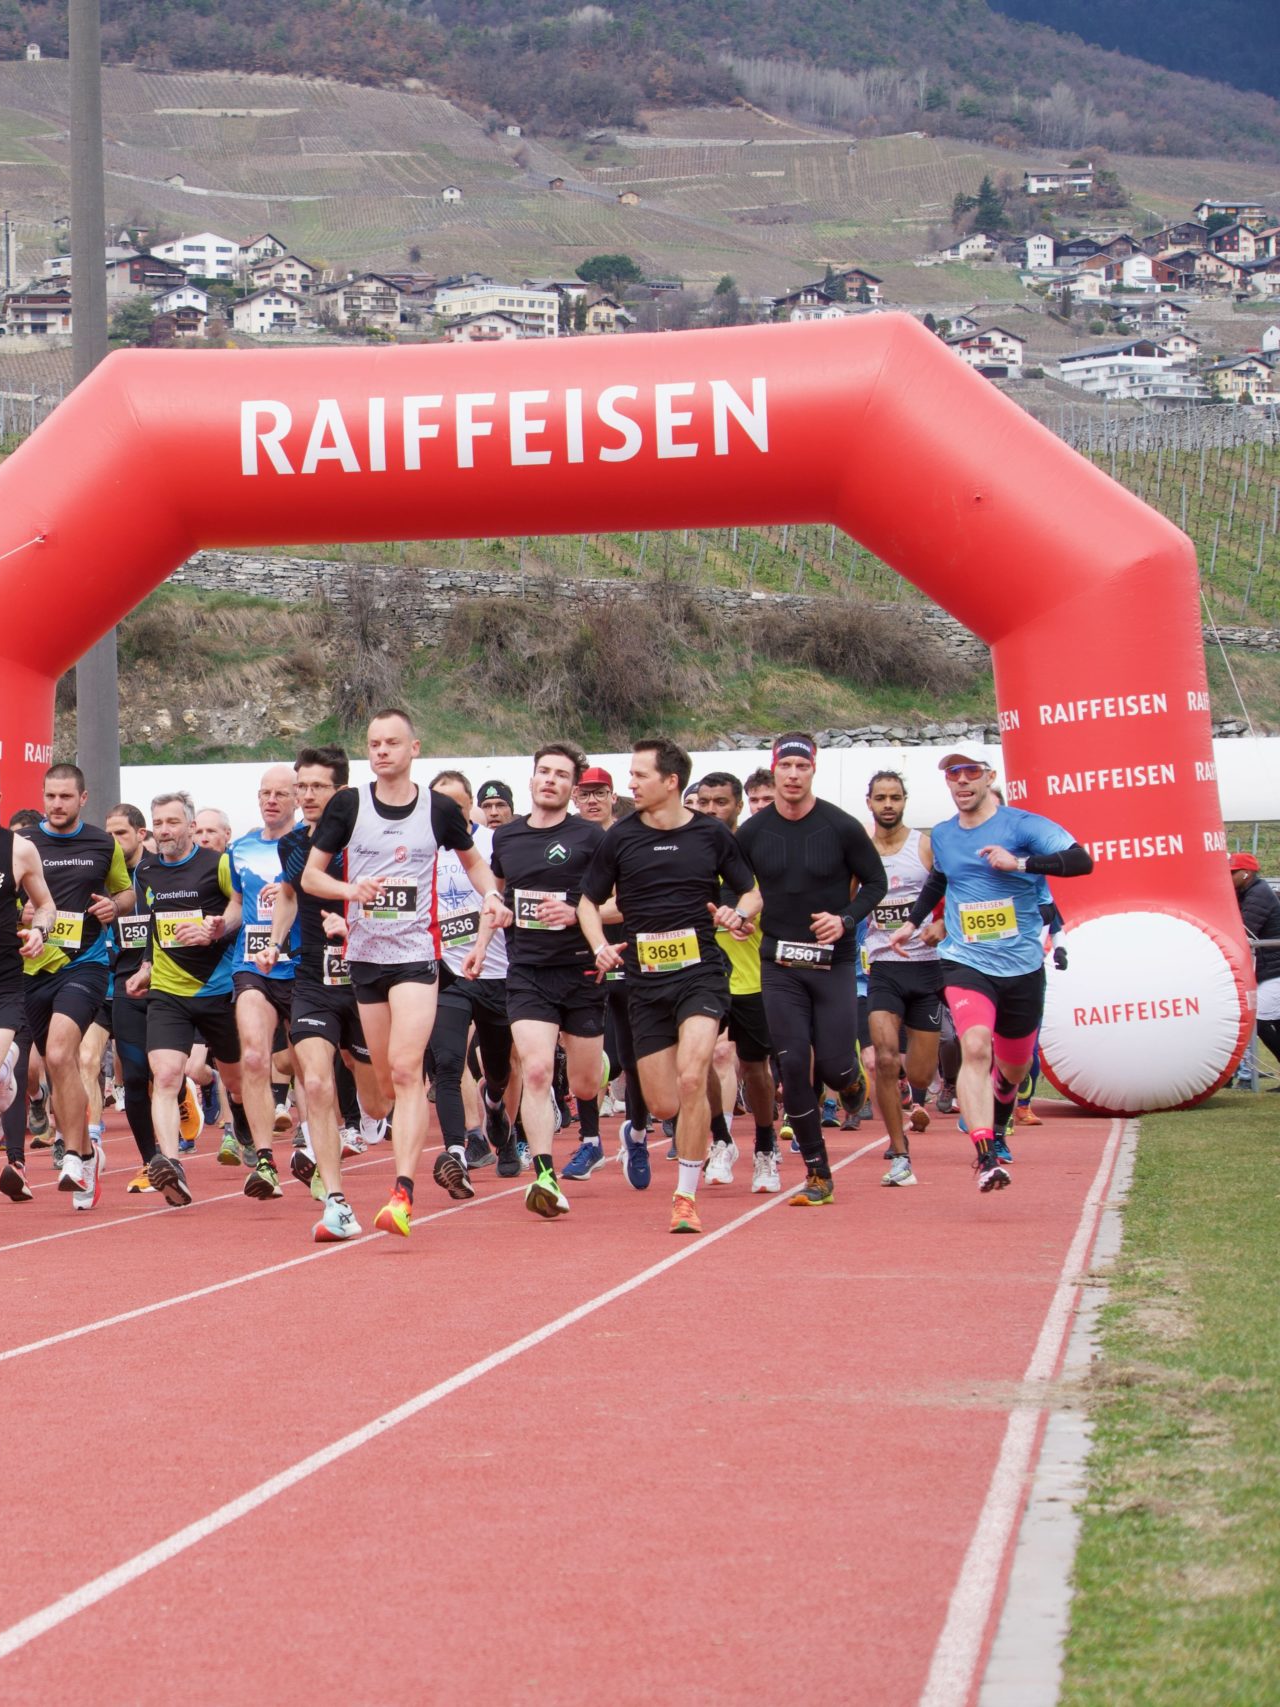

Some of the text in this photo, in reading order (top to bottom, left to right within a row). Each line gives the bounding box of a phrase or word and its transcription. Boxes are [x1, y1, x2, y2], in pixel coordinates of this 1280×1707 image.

[240, 377, 769, 476] RAIFFEISEN
[1039, 693, 1168, 725] RAIFFEISEN
[1047, 763, 1175, 796] RAIFFEISEN
[1083, 834, 1184, 862] IFFEISEN
[43, 858, 94, 867] Constellium
[156, 889, 199, 900] Constellium
[366, 891, 407, 907] 518
[521, 903, 538, 917] 25
[965, 901, 1005, 911] RAIFFEISEN
[876, 907, 911, 921] 2514
[967, 912, 1007, 930] 3659
[50, 923, 75, 938] 87
[124, 925, 148, 938] 250
[163, 923, 176, 936] 36
[440, 917, 474, 937] 2536
[249, 936, 271, 951] 253
[645, 930, 687, 942] RAIFFEISEN
[648, 942, 688, 960] 3681
[784, 947, 821, 963] 2501
[330, 959, 348, 973] 25
[1073, 997, 1200, 1026] RAIFFEISEN
